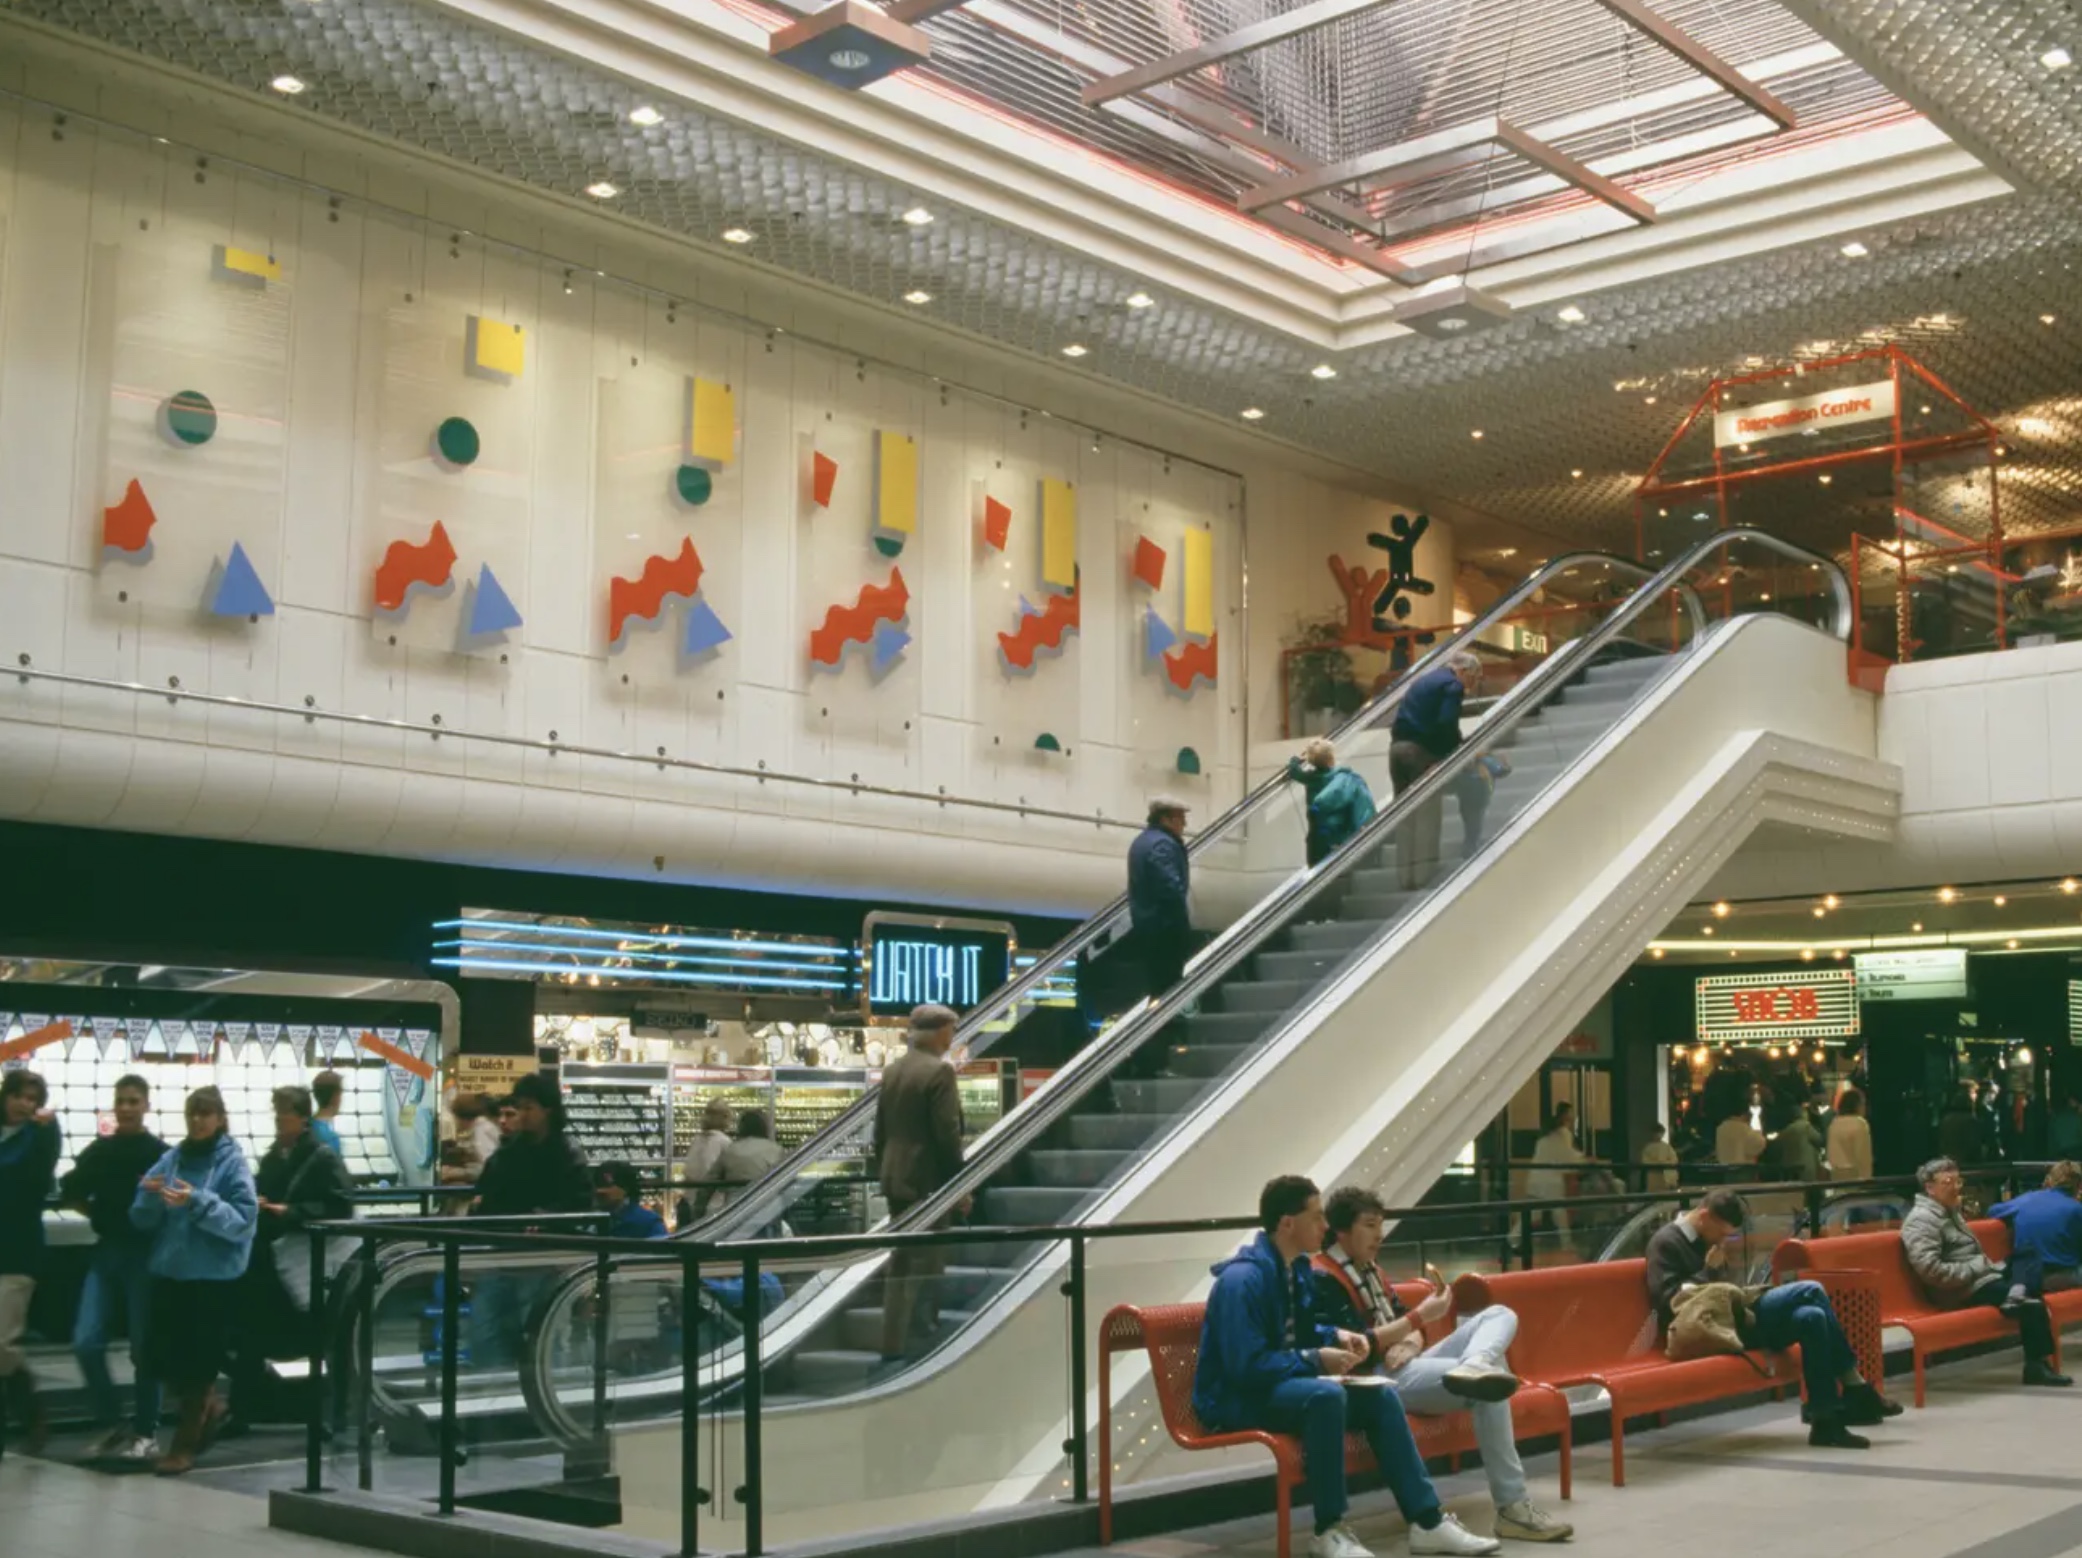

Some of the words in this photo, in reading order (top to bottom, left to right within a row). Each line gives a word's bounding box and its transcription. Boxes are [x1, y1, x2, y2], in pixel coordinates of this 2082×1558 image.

[1820, 397, 1872, 418] Centre
[1522, 630, 1547, 654] EXIT
[870, 939, 953, 1005] WATCH
[962, 945, 982, 1006] IT
[469, 1057, 504, 1071] Watch
